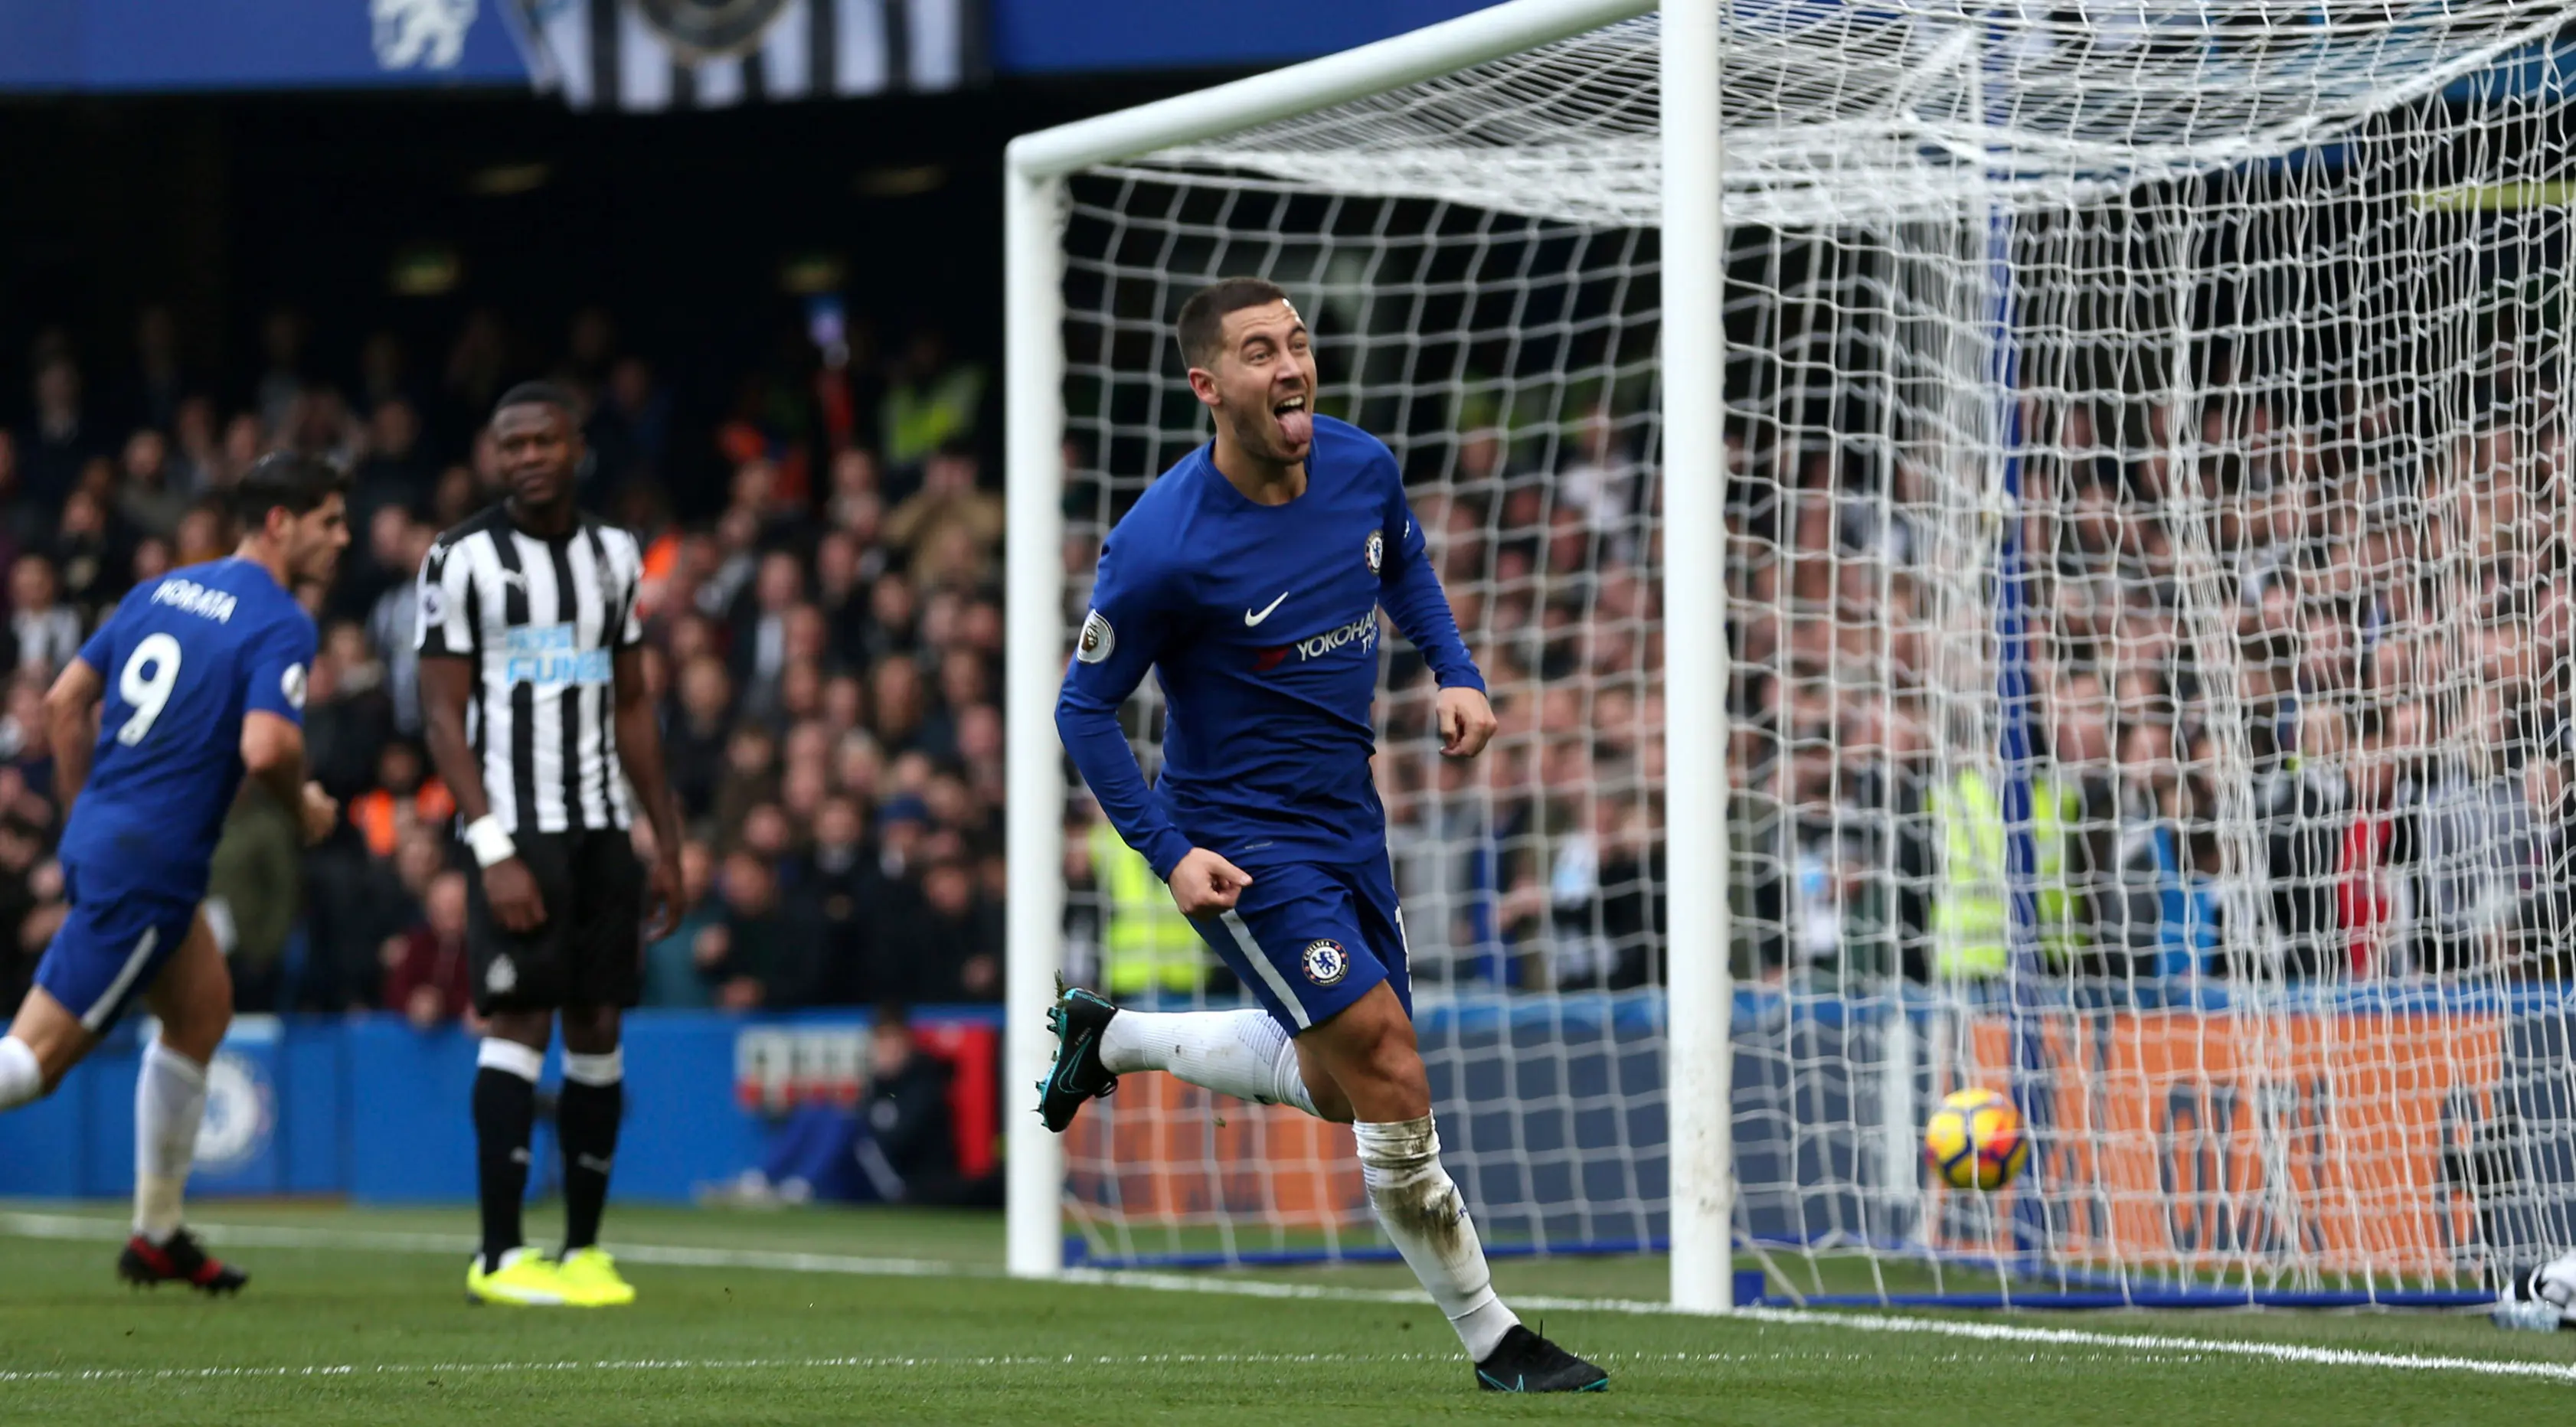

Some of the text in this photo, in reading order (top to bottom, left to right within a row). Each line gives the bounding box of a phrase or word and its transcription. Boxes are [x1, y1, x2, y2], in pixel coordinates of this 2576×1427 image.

[150, 579, 237, 625] MORATA
[119, 632, 182, 747] 9
[1304, 941, 1330, 961] CHELSEA
